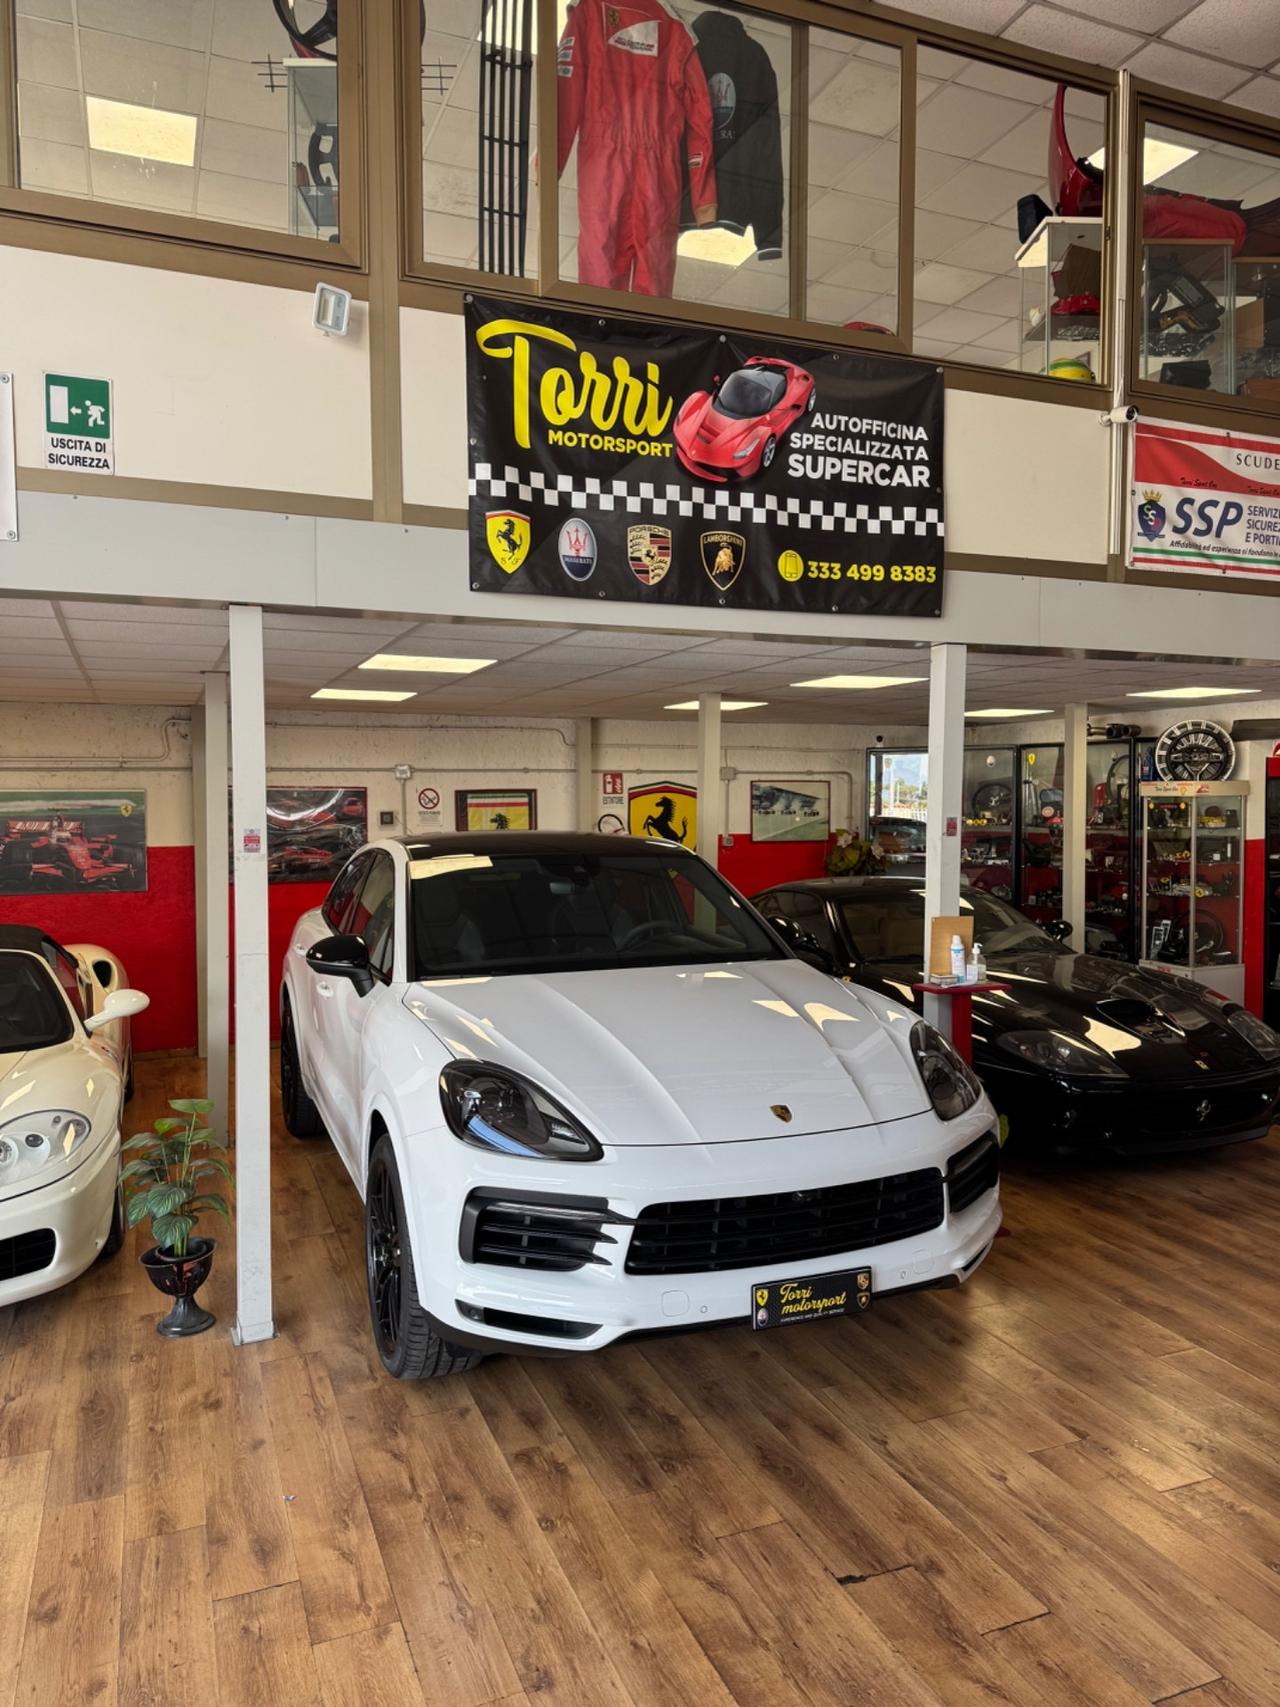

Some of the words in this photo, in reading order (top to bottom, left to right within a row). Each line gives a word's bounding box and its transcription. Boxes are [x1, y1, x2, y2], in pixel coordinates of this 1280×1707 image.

[476, 319, 673, 449] Torri
[811, 412, 929, 441] AUTOFFICINA
[51, 437, 92, 452] USCITA
[95, 442, 106, 453] DI
[548, 430, 673, 457] MOTORSPORT
[789, 432, 929, 461] SPECIALIZZATA
[48, 453, 110, 469] SICUREZZA
[787, 453, 931, 488] SUPERCAR
[1236, 453, 1280, 471] SCUDE
[1172, 497, 1243, 538] SSP
[1245, 532, 1252, 543] E
[808, 561, 841, 580] 333
[847, 564, 885, 581] 499
[890, 565, 937, 583] 8383
[779, 1283, 812, 1303] Torri
[781, 1291, 847, 1315] motorsport
